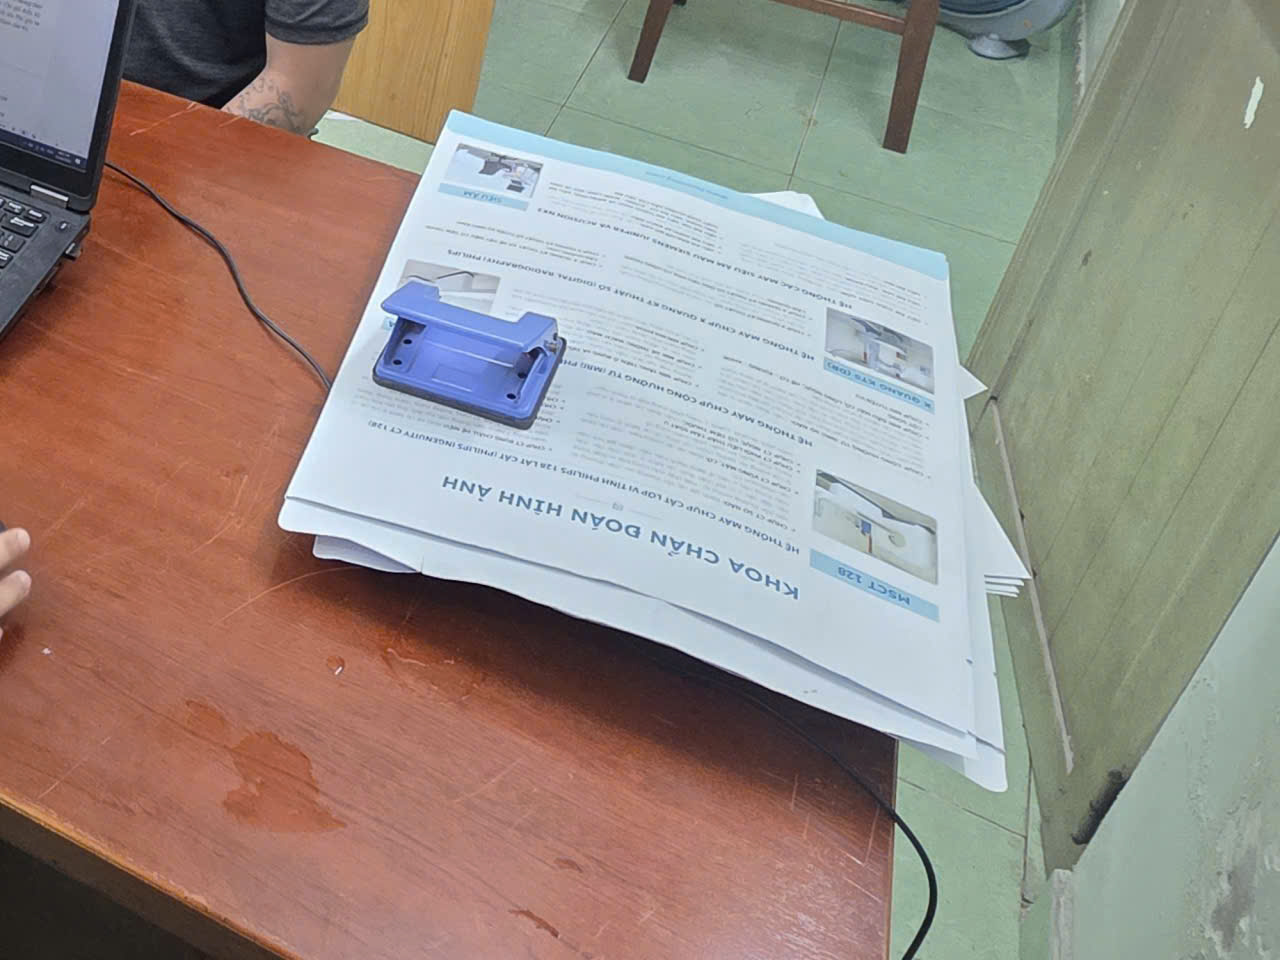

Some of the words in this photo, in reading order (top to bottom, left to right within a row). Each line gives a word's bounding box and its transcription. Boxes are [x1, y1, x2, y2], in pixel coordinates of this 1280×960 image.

[446, 248, 481, 260] PHILIPS
[660, 303, 697, 320] QUANG
[879, 383, 919, 404] QUANG
[389, 426, 402, 434] CT
[402, 429, 455, 447] INGENUITY
[539, 462, 557, 470] 128
[560, 467, 599, 482] PHILIPS
[442, 475, 491, 501] ẢNH
[571, 508, 640, 538] ĐOÁN
[651, 530, 719, 564] CHẨN
[727, 557, 798, 600] KHOA
[837, 566, 861, 583] 128
[868, 579, 909, 605] MSCT
